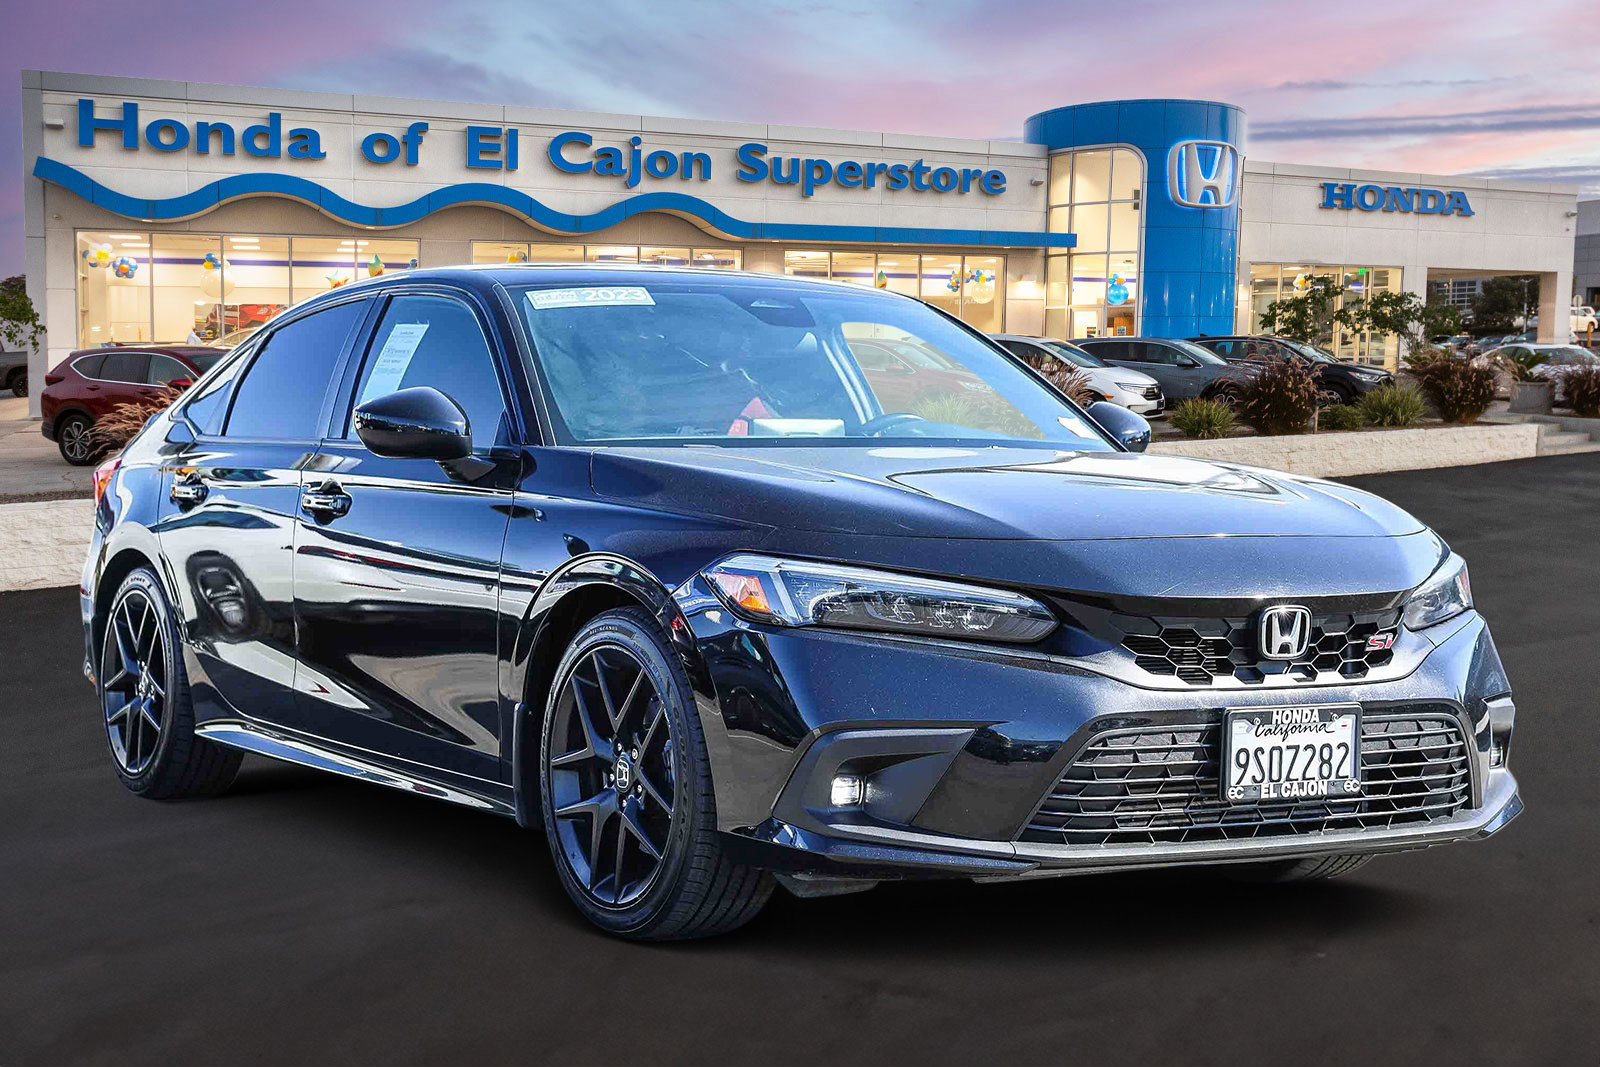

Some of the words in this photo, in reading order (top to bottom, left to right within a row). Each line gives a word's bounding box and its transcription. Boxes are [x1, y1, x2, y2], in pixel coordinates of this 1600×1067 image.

[78, 98, 326, 161] Honda
[361, 122, 429, 166] of
[466, 125, 519, 171] El
[547, 131, 712, 190] Cajon
[736, 143, 1008, 198] Superstore
[1319, 182, 1475, 217] HONDA
[581, 289, 648, 301] 2023
[1271, 708, 1320, 725] HONDA
[1254, 722, 1335, 742] California
[1260, 783, 1278, 799] EL
[1281, 780, 1328, 798] CAJON
